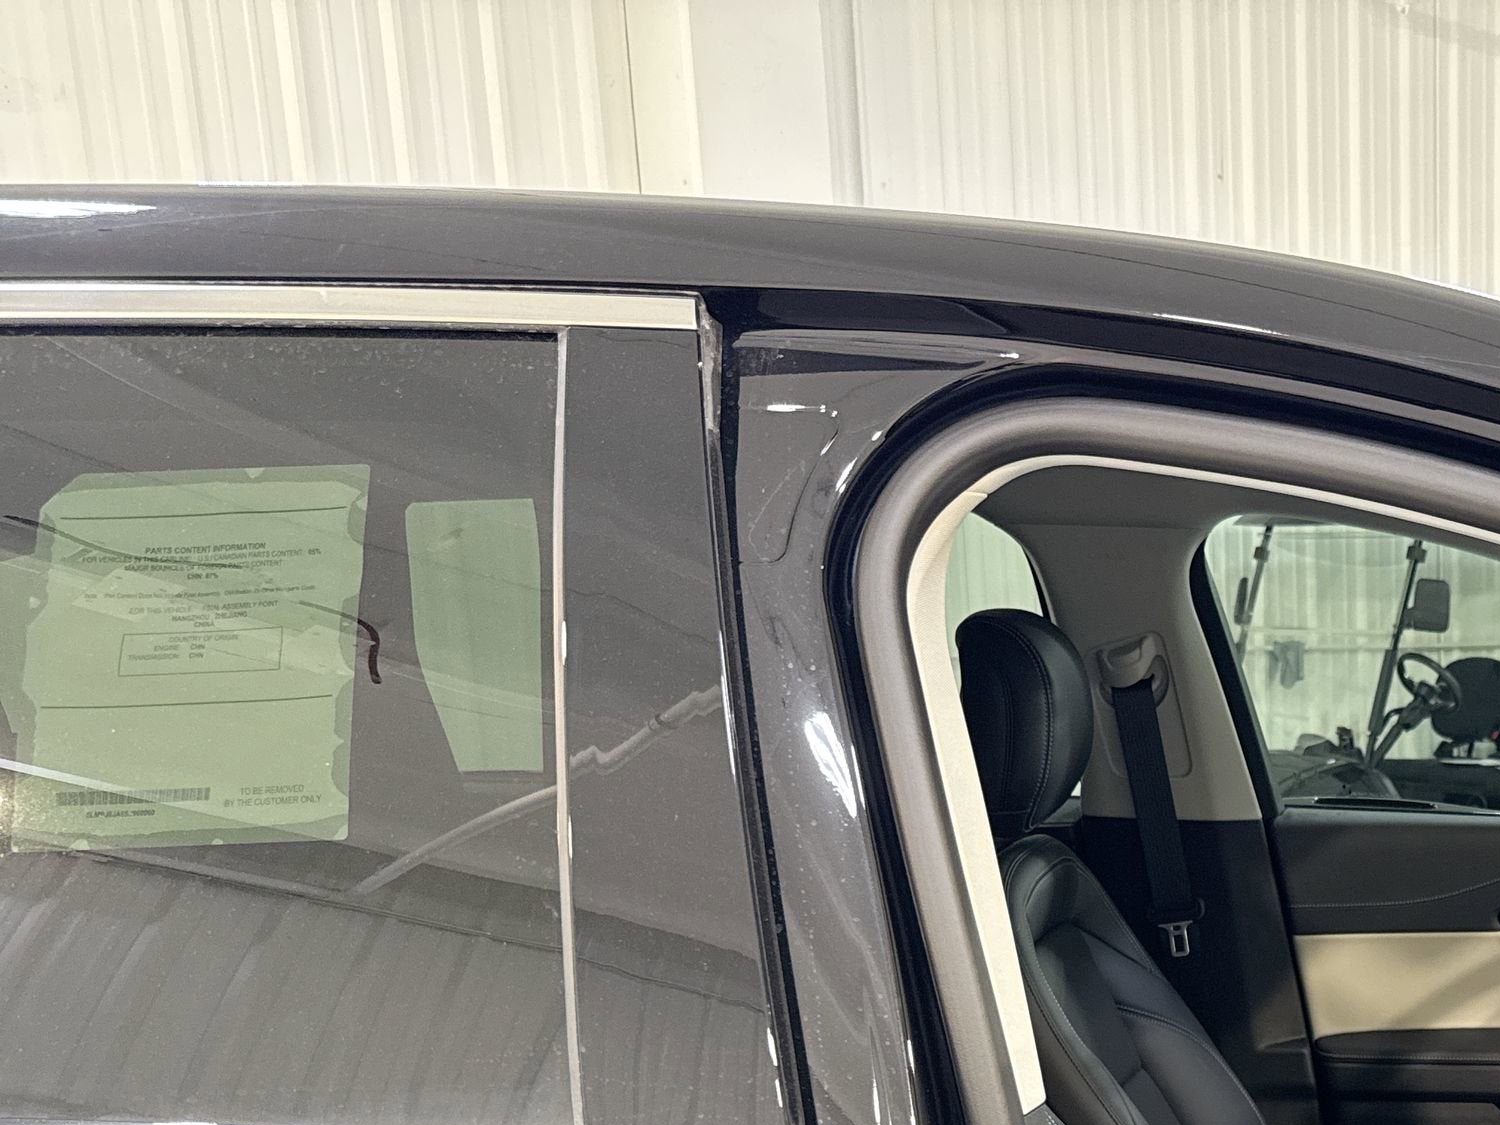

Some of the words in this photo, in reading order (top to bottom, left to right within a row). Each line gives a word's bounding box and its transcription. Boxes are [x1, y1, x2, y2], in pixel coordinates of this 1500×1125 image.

[145, 546, 173, 555] PARTS
[174, 545, 212, 555] CONTENT
[213, 542, 267, 553] INFORMATION
[241, 786, 252, 796] TO
[252, 785, 264, 795] BE
[264, 783, 304, 794] REMOVED
[223, 799, 234, 808] BY
[237, 798, 252, 807] THE
[253, 795, 299, 806] CUSTOMER
[300, 793, 322, 804] ONLY
